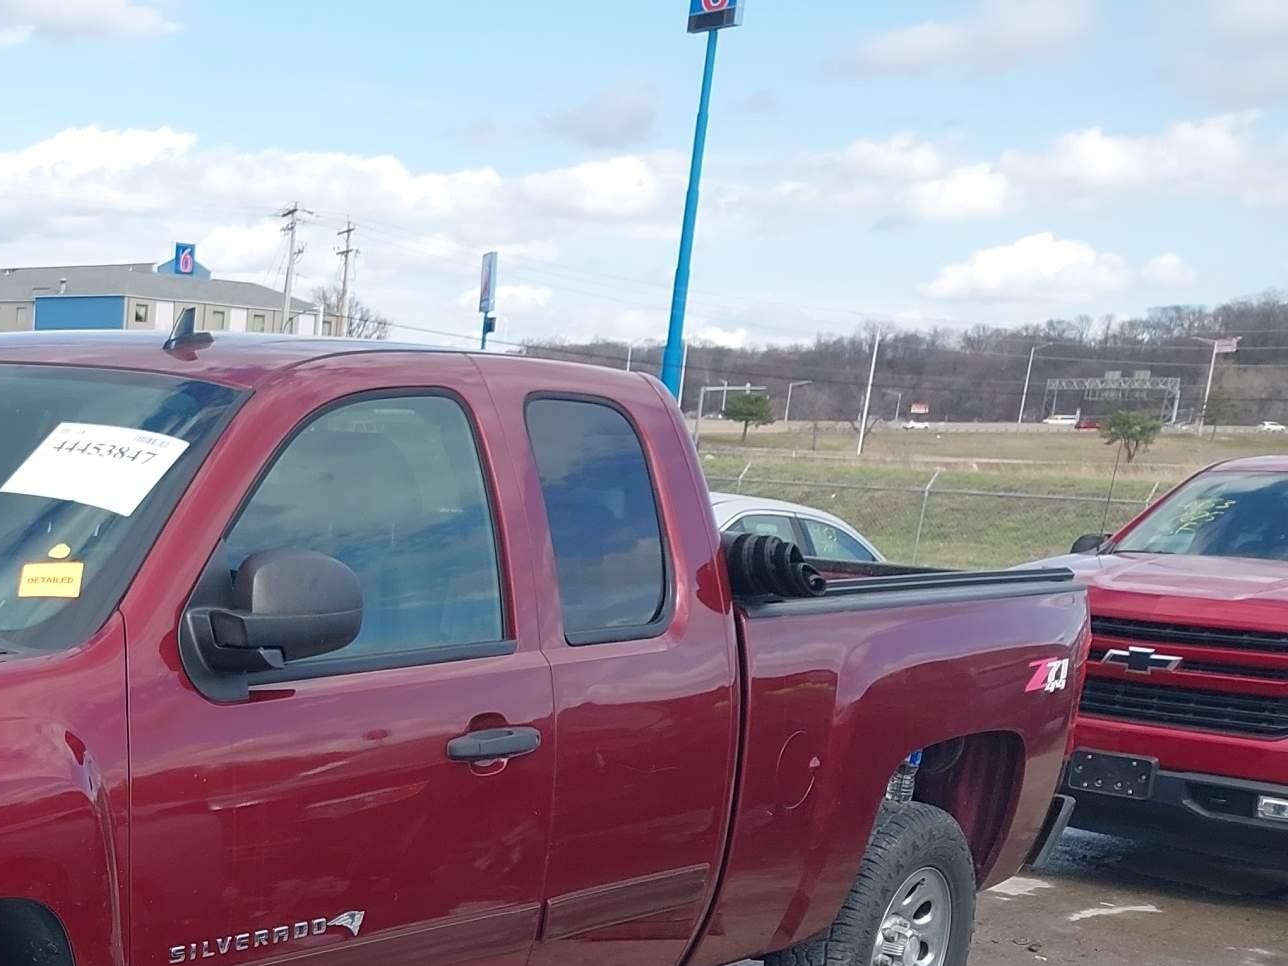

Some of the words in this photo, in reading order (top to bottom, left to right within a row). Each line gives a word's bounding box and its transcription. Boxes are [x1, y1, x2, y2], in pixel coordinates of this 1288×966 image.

[179, 247, 193, 273] 6
[53, 441, 157, 464] 44453847
[27, 576, 74, 584] DETAILED
[1025, 657, 1069, 692] Z71
[169, 917, 327, 964] SILVERADO
